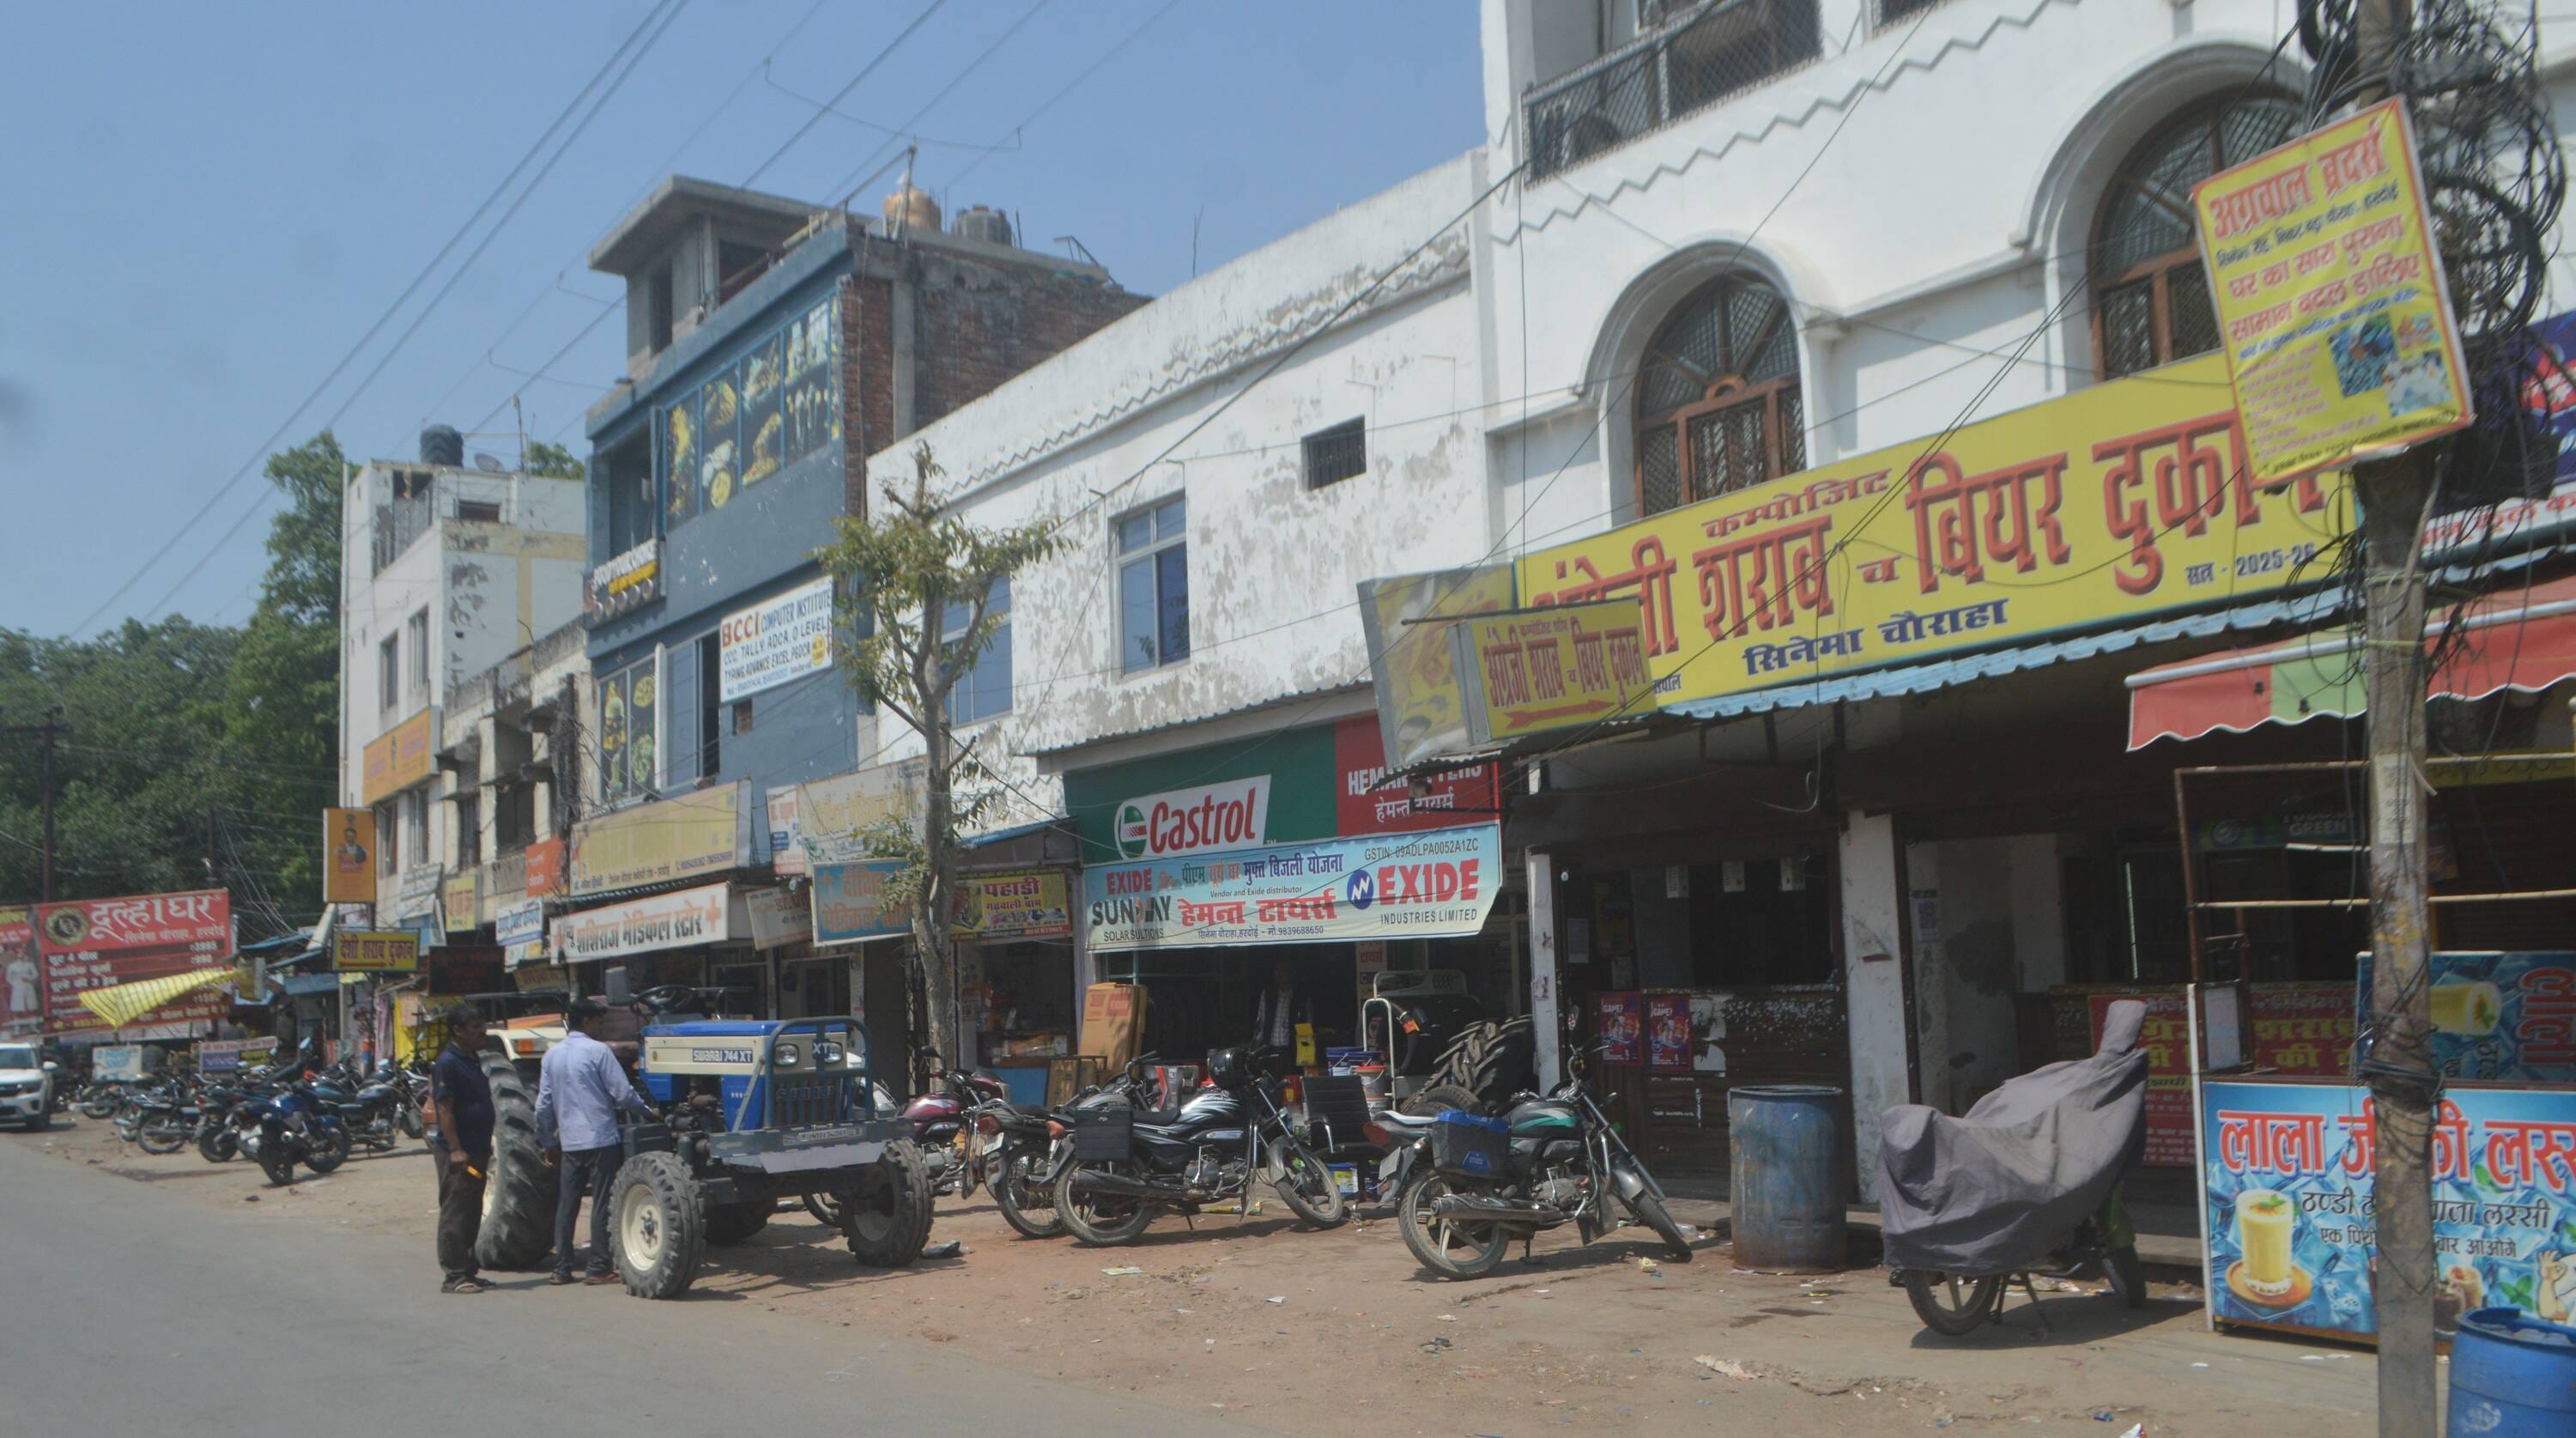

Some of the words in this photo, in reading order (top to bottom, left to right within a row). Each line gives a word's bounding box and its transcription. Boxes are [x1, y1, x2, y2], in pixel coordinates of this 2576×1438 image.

[2209, 161, 2316, 240] अग्रवाल
[2317, 115, 2390, 200] ब्रदर्स
[2227, 271, 2259, 301] घर
[2260, 258, 2292, 288] का
[2294, 240, 2338, 277] सारा
[2342, 213, 2405, 268] पुराना
[2228, 298, 2294, 343] सामान
[2297, 276, 2349, 314] बदल
[2351, 251, 2422, 298] डालिए
[1692, 514, 1834, 642] शराब
[1856, 555, 1902, 584] व
[1904, 451, 2071, 594] बियर
[2091, 406, 2326, 596] दुका
[1700, 469, 1893, 538] कम्पोजिट
[2234, 541, 2317, 578] 2025-26
[722, 610, 760, 648] BCCI
[761, 602, 795, 633] COMPUTER
[797, 589, 832, 619] INSTITUTE
[1570, 616, 1609, 695] बियर
[1742, 628, 1864, 677] सिनेमा
[1877, 598, 2009, 646] चौराहा
[1482, 624, 1530, 708] अंग्रेजी
[1525, 636, 1567, 701] शराब
[1567, 669, 1578, 684] व
[1612, 626, 1646, 709] दुकान
[1150, 787, 1256, 853] Castrol
[1374, 797, 1409, 824] हेमन्त
[2288, 819, 2347, 837] GREEN
[1181, 862, 1205, 884] पीएम
[1269, 851, 1305, 878] बिजली
[1306, 850, 1345, 874] योजना
[1365, 847, 1394, 861] GSTIN:
[1106, 867, 1153, 895] EXIDE
[1210, 889, 1233, 898] Vendor
[1233, 889, 1246, 897] and
[1246, 888, 1265, 896] Exide
[1266, 885, 1303, 895] distributor
[1377, 859, 1480, 907] EXIDE
[90, 899, 167, 942] दूल्हा
[167, 895, 215, 922] घर
[621, 908, 670, 945] मेडिकल
[674, 899, 703, 937] स्टोर
[1178, 898, 1246, 927] हेमन्त
[1256, 887, 1338, 924] टायर्स
[1380, 911, 1437, 925] INDUSTRIES
[1439, 908, 1477, 922] LIMITED
[363, 939, 386, 959] शराब
[387, 940, 415, 966] दुकान
[1103, 929, 1130, 942] SOLAR
[1130, 927, 1165, 940] SULTIONS
[1197, 928, 1217, 938] सिनेमा
[724, 1049, 739, 1062] 744
[739, 1048, 753, 1062] XT
[812, 1041, 831, 1055] XT
[2218, 1110, 2327, 1176] लाला
[2302, 1186, 2355, 1216] ठण्डी
[2483, 1197, 2552, 1229] लस्सी
[2320, 1227, 2343, 1245] एक
